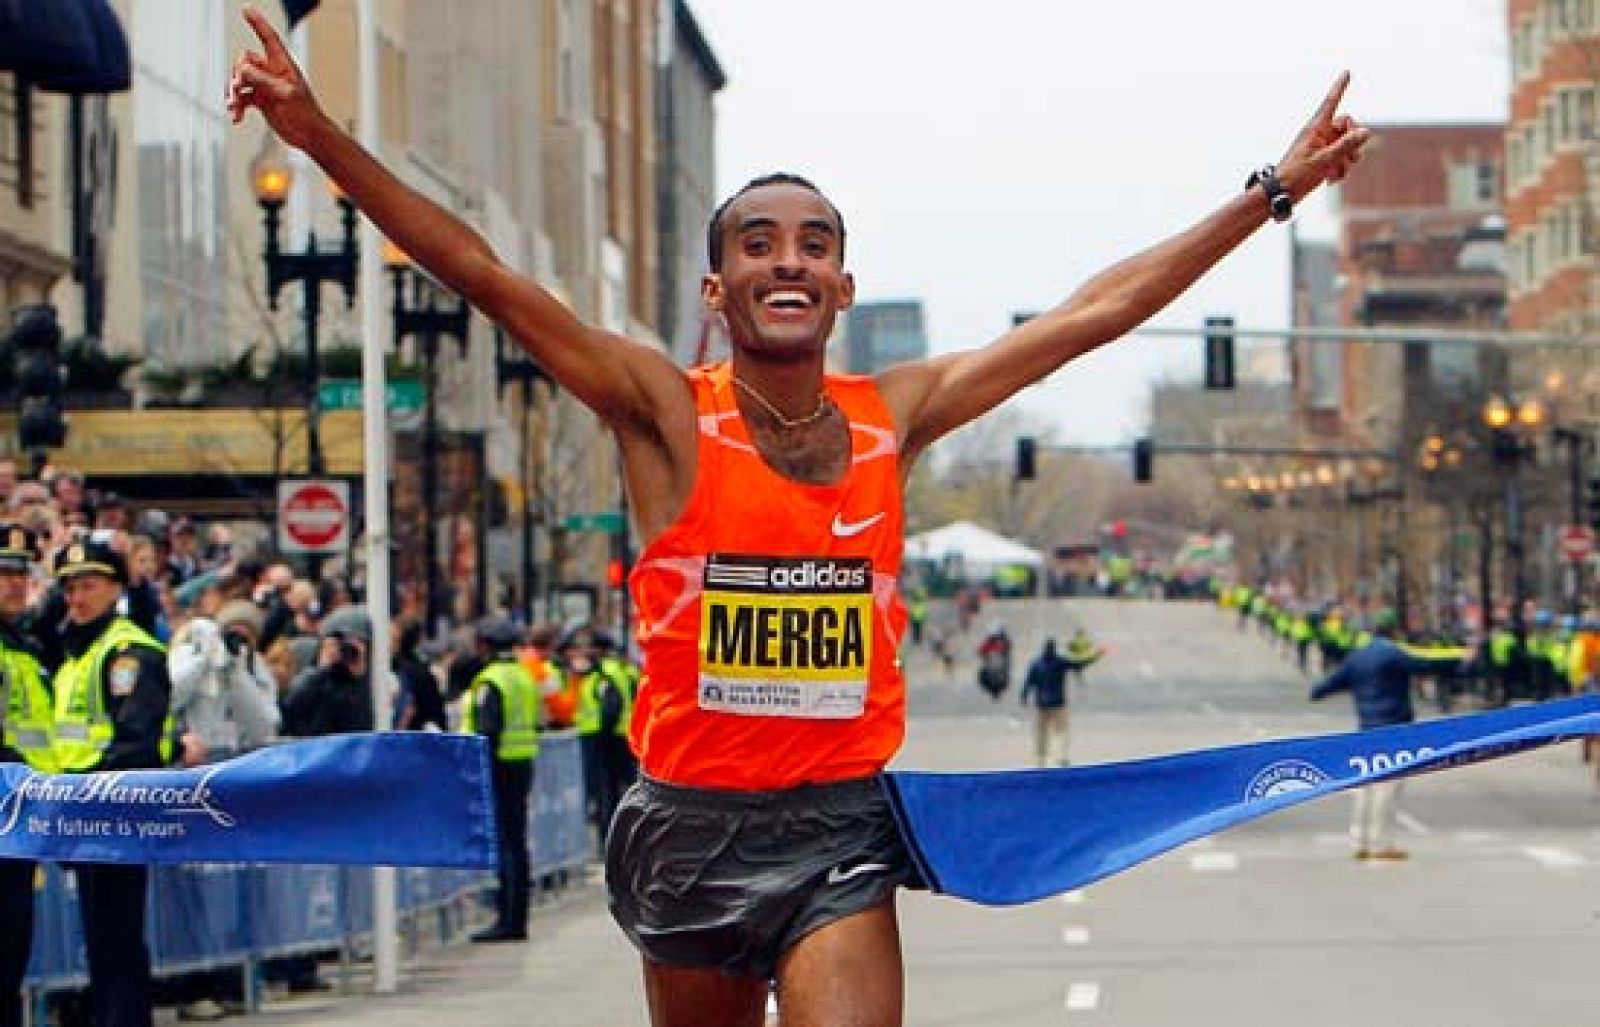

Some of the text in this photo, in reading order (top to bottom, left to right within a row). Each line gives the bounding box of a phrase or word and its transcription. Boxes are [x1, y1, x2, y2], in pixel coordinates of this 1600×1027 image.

[770, 561, 865, 588] adidas
[706, 604, 865, 669] MERGA
[0, 767, 235, 834] John Hancock
[57, 814, 112, 836] future
[118, 815, 131, 836] is
[136, 820, 188, 839] yours
